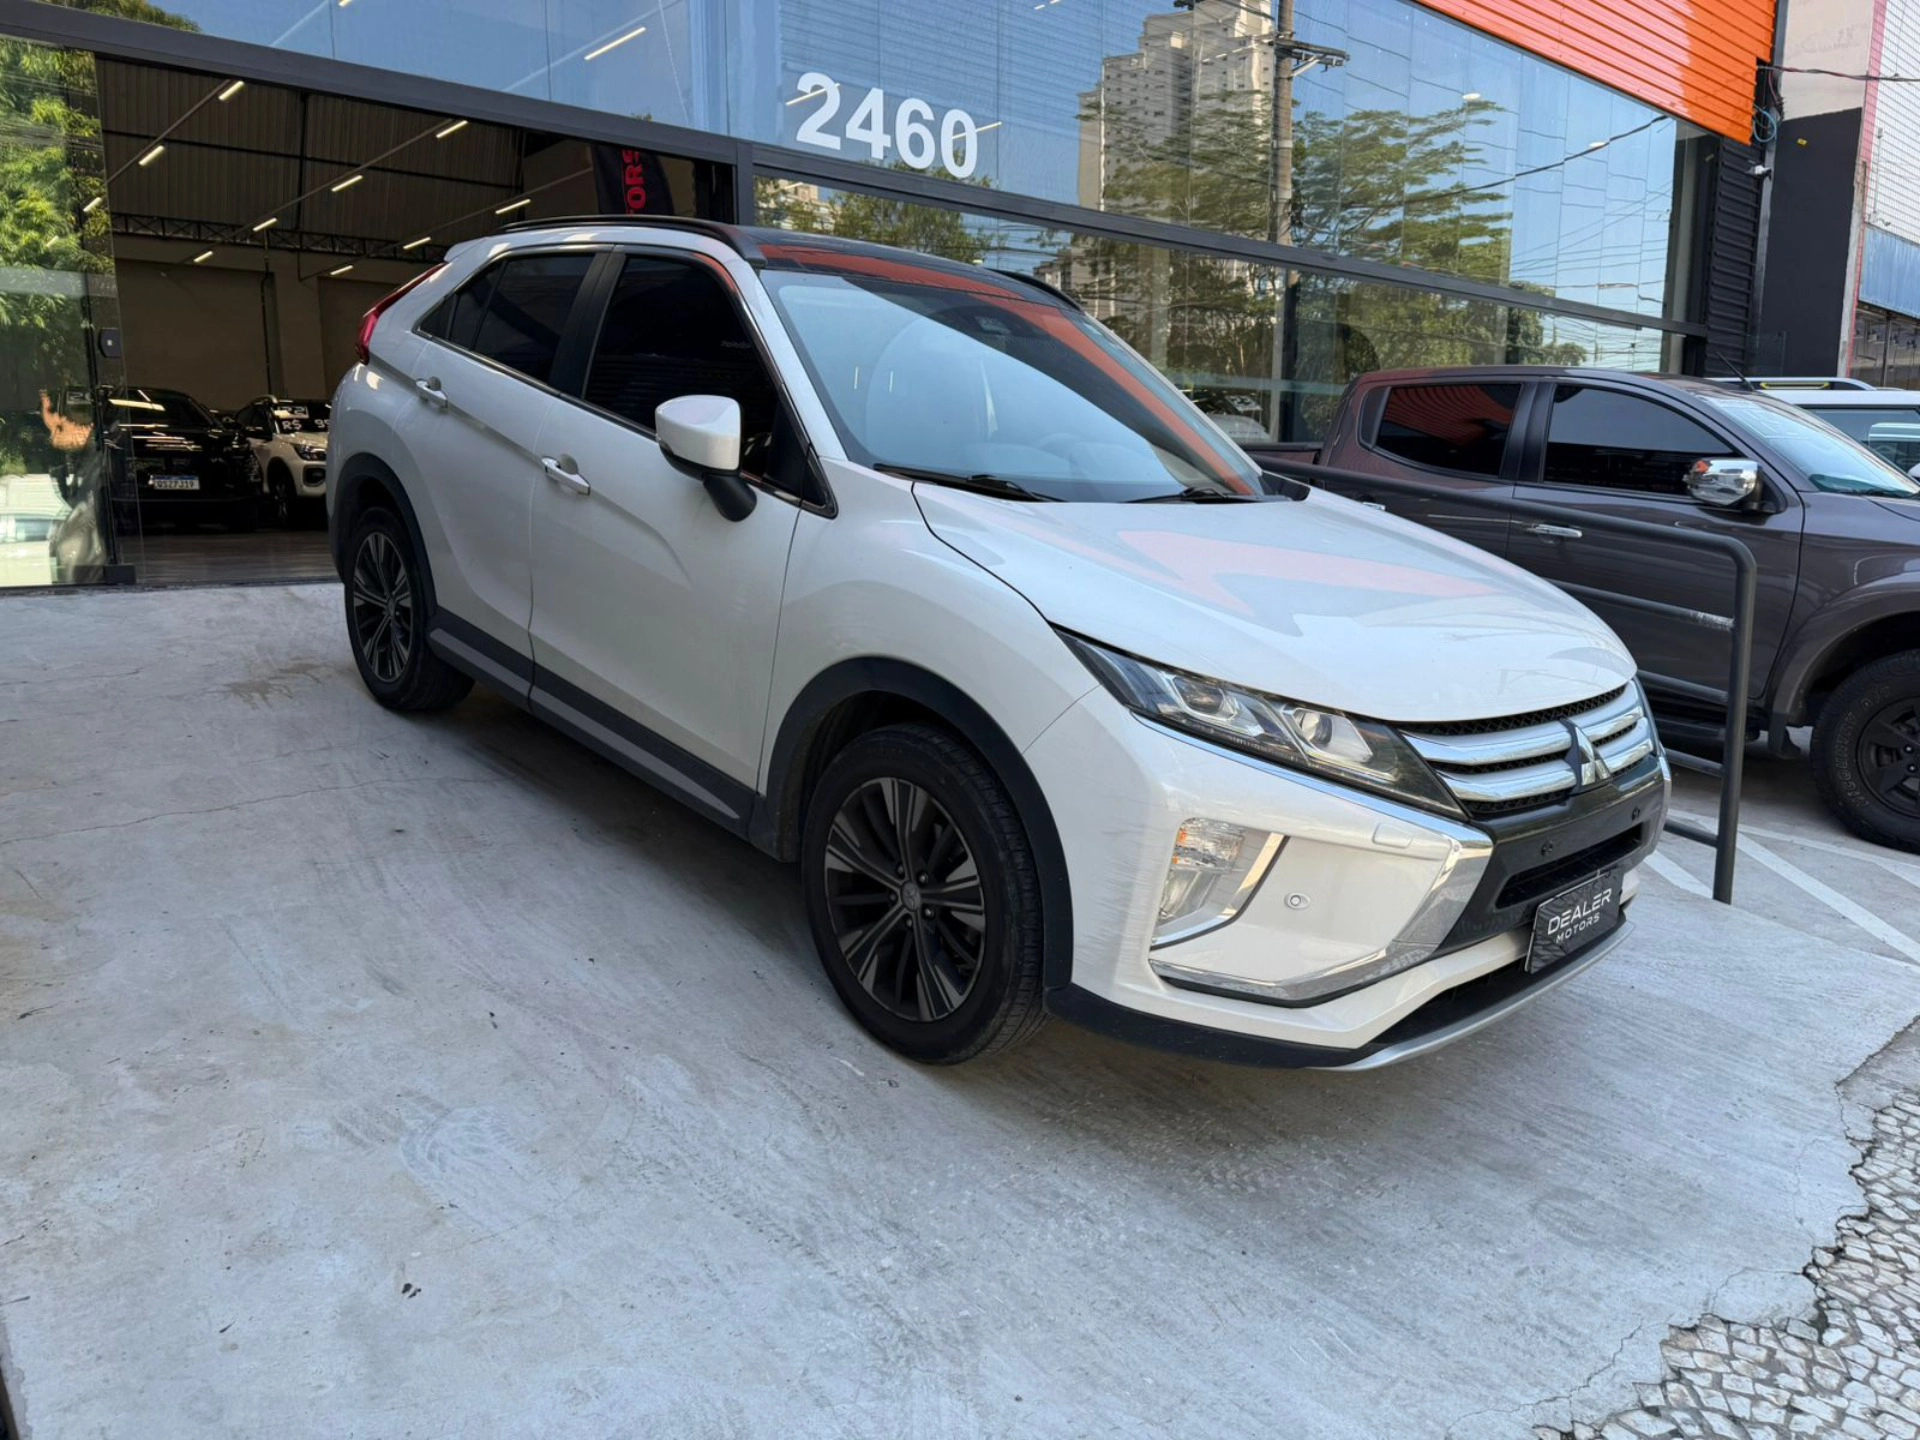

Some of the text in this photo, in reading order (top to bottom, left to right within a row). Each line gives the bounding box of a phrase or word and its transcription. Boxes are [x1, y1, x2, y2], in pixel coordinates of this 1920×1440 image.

[796, 72, 978, 179] 2460
[282, 420, 302, 430] R$
[1547, 888, 1612, 936] DEALER
[1555, 912, 1601, 944] MOTORS
